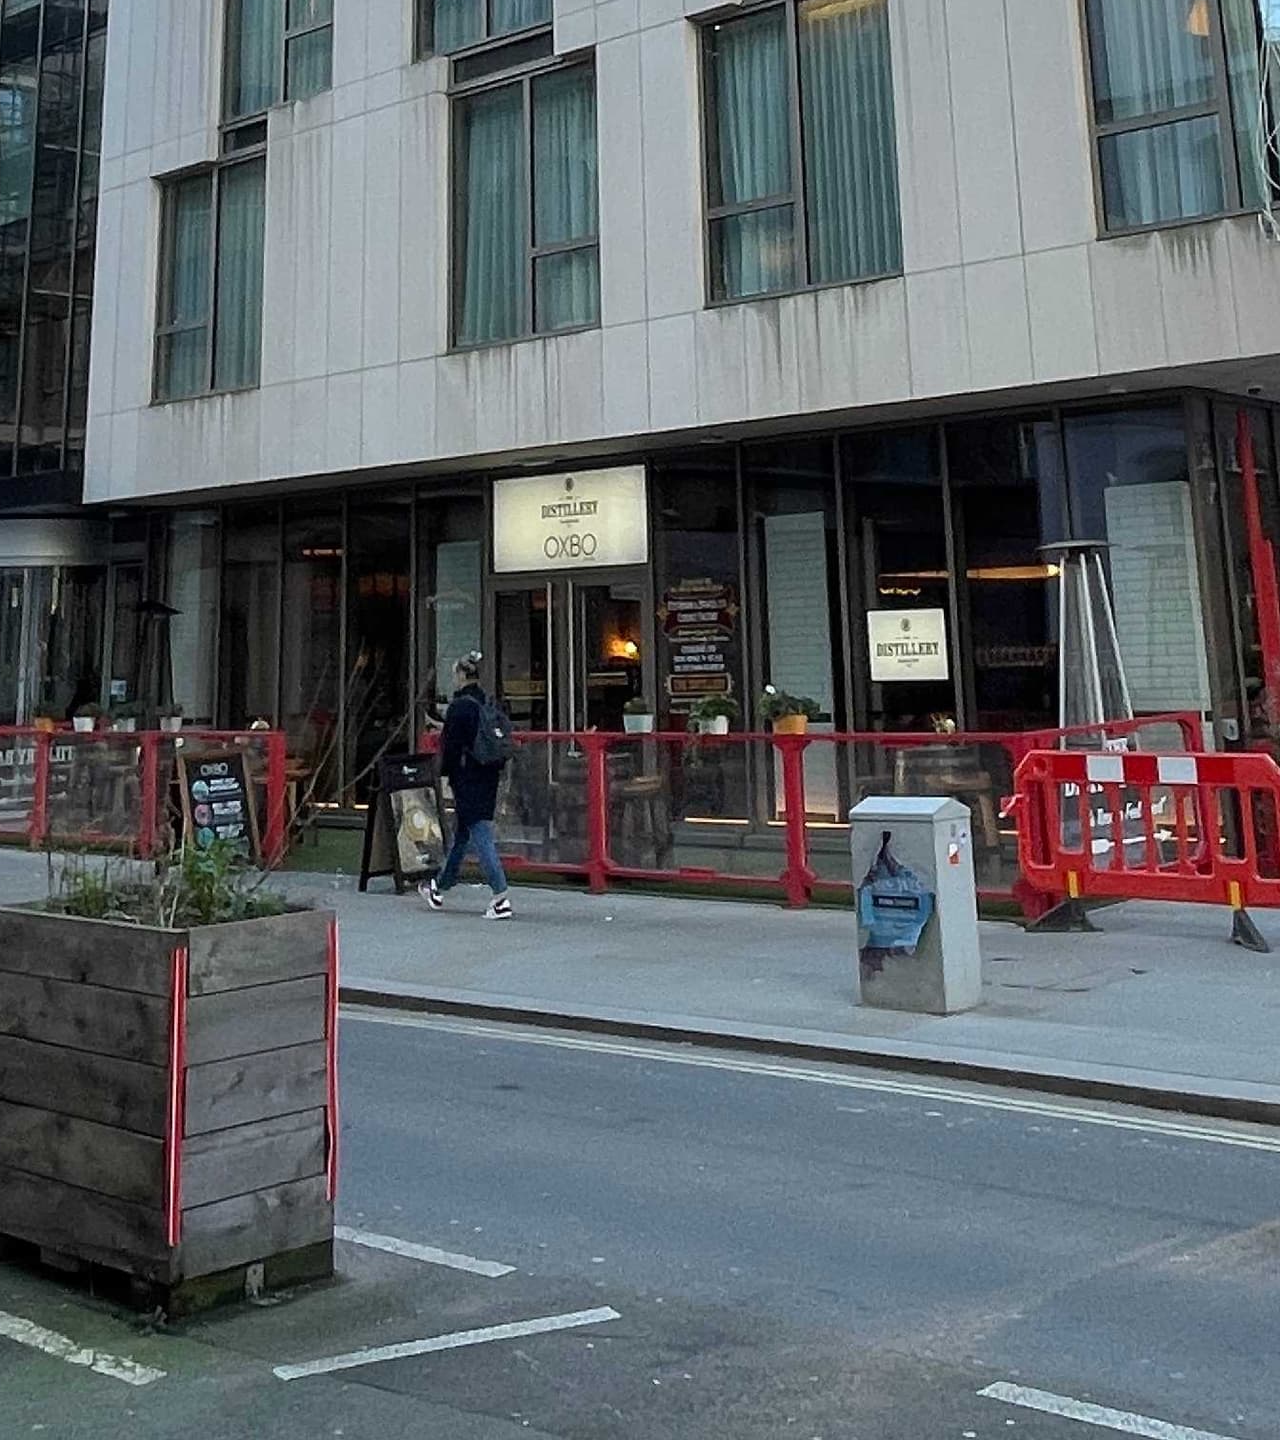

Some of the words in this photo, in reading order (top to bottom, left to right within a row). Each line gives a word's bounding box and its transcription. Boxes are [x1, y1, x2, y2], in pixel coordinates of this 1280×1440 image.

[541, 500, 598, 519] DISTILLERY
[543, 533, 597, 559] OXBO
[876, 641, 939, 657] DISTILLERY
